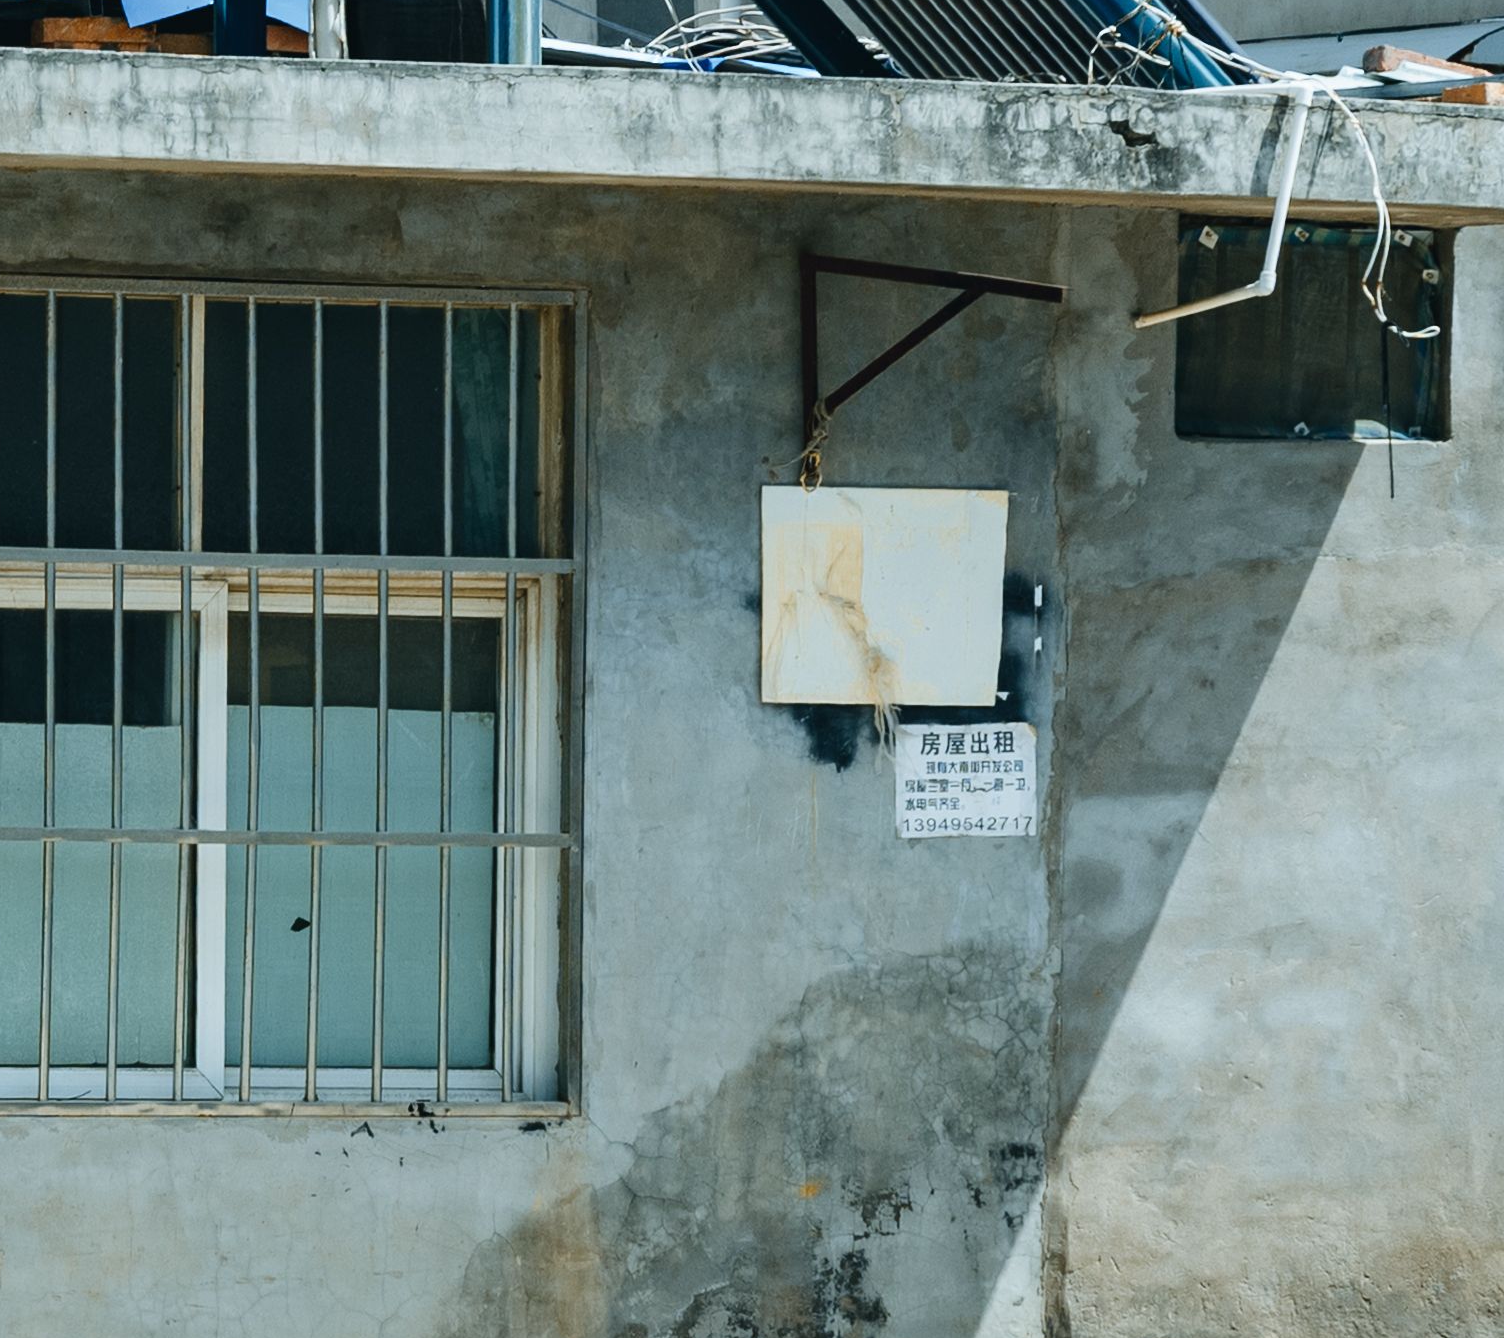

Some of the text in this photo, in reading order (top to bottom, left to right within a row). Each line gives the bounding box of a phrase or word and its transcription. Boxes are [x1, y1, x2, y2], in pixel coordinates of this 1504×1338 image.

[920, 730, 1016, 756] 房屋出租
[902, 816, 1033, 833] 13949542717
